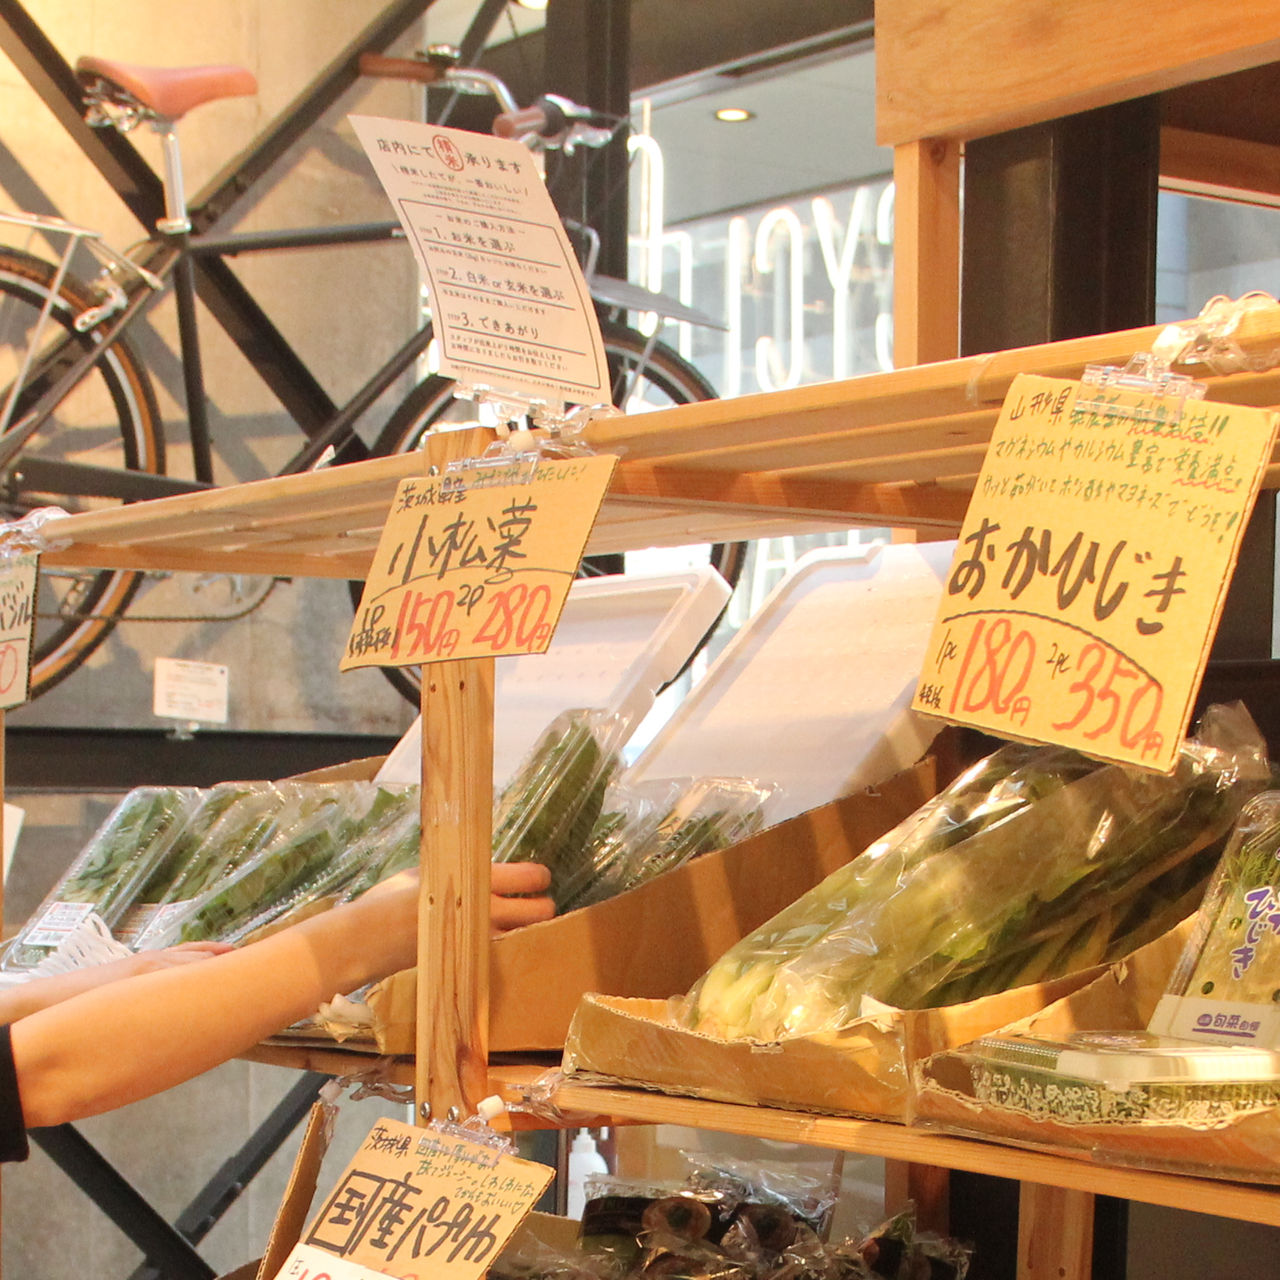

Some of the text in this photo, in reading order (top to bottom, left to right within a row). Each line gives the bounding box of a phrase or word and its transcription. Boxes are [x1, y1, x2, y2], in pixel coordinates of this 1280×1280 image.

[377, 139, 437, 158] 店内にて
[465, 152, 522, 174] 承ります
[451, 231, 516, 253] お米を選ぶ
[466, 270, 489, 287] 白米
[1008, 385, 1073, 426] 山形県
[387, 496, 538, 586] 小松菜
[948, 516, 1188, 636] おかひじき
[305, 1169, 502, 1264] 国産パプリカ
